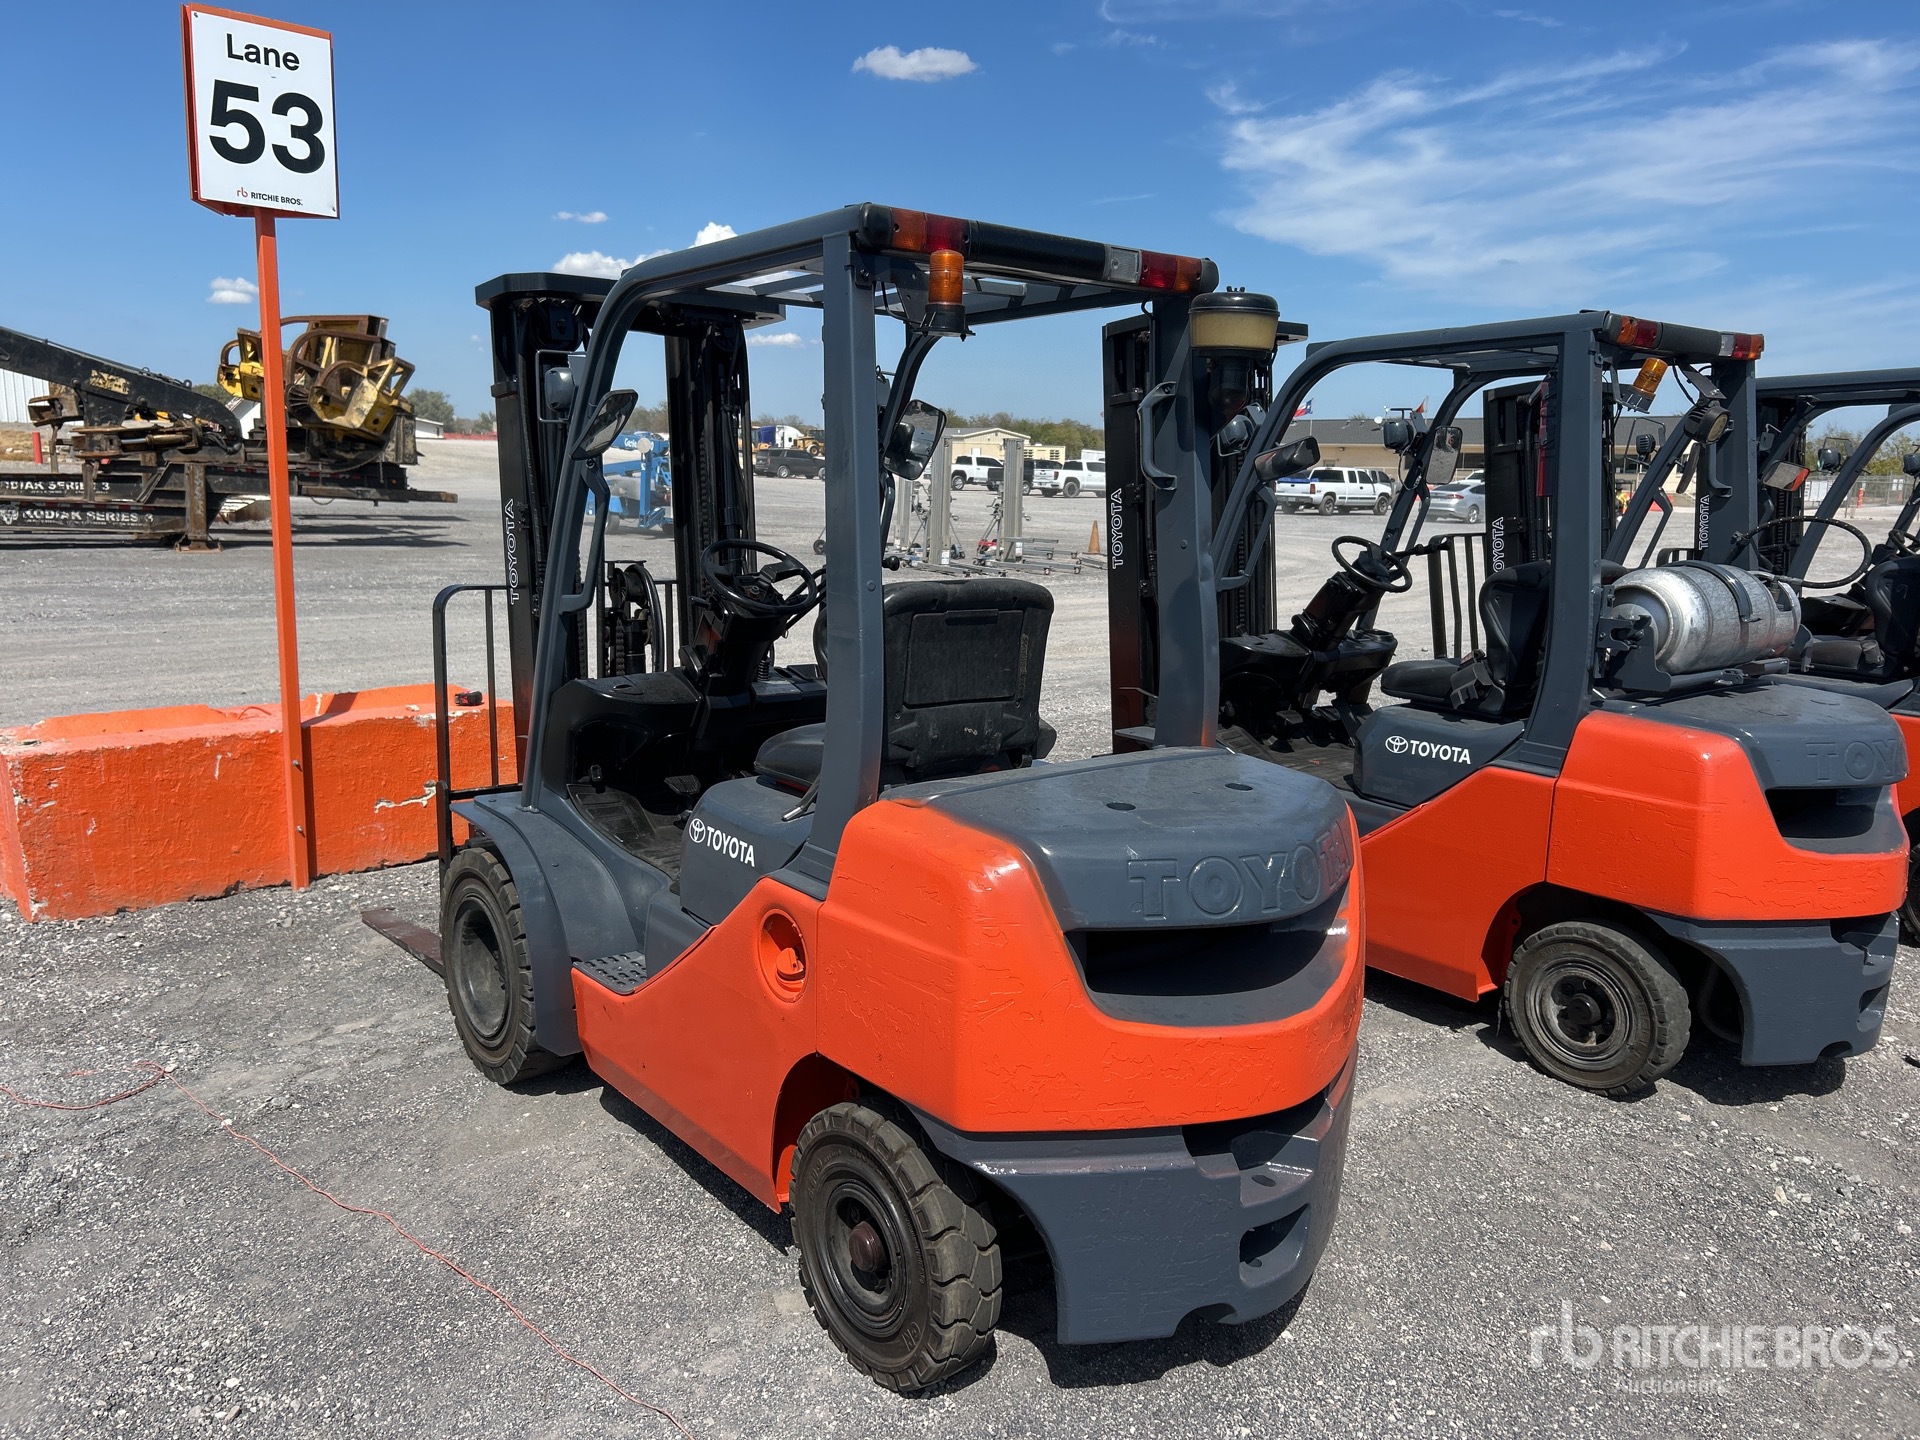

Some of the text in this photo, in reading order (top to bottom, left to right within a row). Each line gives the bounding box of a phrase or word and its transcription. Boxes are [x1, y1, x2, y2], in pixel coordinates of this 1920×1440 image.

[226, 33, 300, 71] Lane
[209, 79, 326, 174] 53
[251, 192, 279, 203] RITCHIE
[281, 197, 303, 206] BROS.
[102, 482, 109, 490] 3
[23, 508, 82, 520] KODIAK
[86, 511, 139, 522] SERIES
[1111, 488, 1123, 569] TOYOTA
[1699, 495, 1709, 550] TOYOTA
[505, 499, 519, 605] TOYOTA
[1492, 516, 1504, 572] OYOTA
[1410, 740, 1471, 765] TOYOTA
[707, 825, 755, 867] TOYOTA
